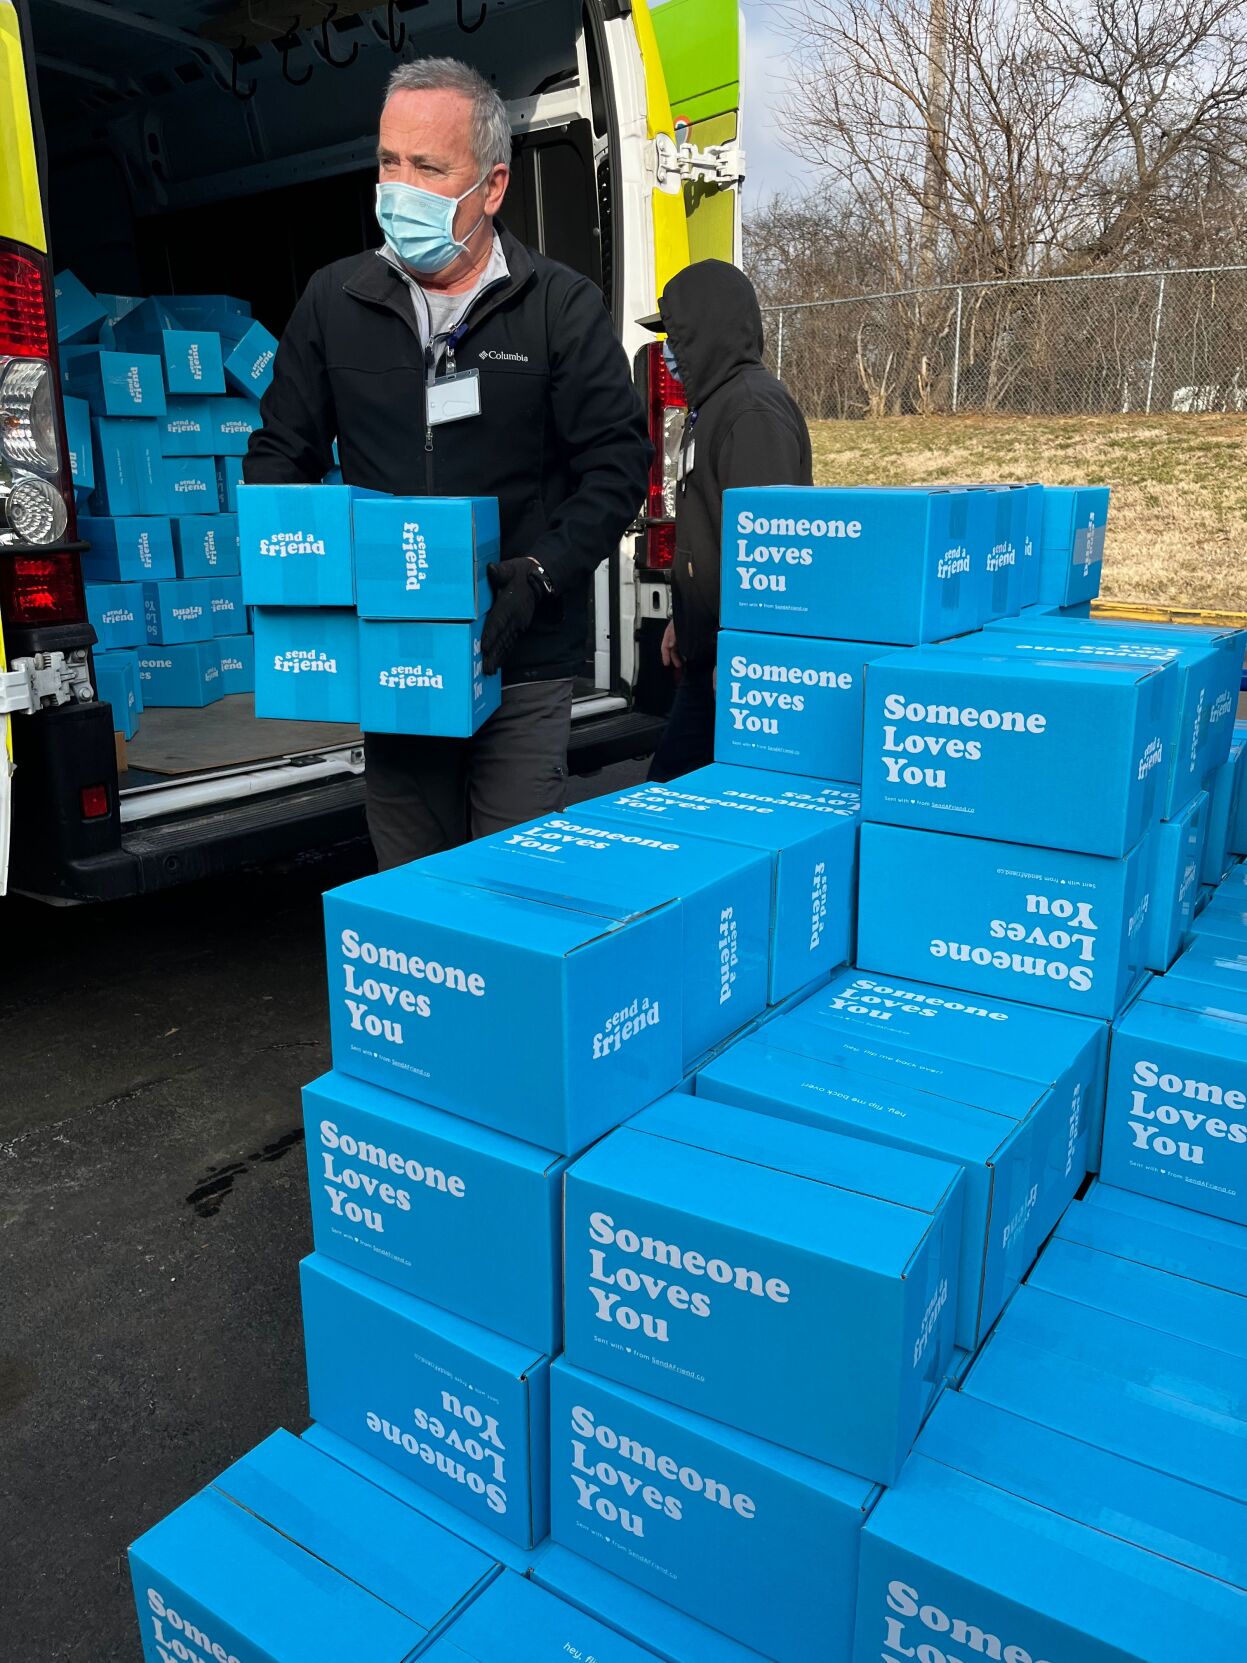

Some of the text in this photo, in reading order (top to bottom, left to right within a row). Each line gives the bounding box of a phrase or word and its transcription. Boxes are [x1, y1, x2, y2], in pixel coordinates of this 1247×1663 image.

[191, 344, 202, 380] friend
[251, 350, 274, 379] friend
[489, 351, 528, 362] Columbia
[131, 367, 142, 403] friend
[168, 424, 200, 432] friend
[221, 424, 253, 432] friend
[175, 484, 206, 492] friend
[271, 531, 314, 542] send a
[737, 511, 861, 537] Someone
[140, 532, 151, 568] friend
[207, 531, 216, 564] friend
[259, 538, 325, 557] friend
[403, 522, 420, 591] friend
[416, 535, 428, 580] send a
[737, 540, 812, 565] Loves
[945, 546, 965, 561] send a
[986, 549, 1015, 572] friend
[992, 541, 1006, 555] send
[1008, 543, 1011, 552] a
[736, 567, 786, 591] You
[938, 555, 970, 578] friend
[103, 613, 133, 623] friend
[172, 607, 202, 616] friend
[274, 656, 337, 673] friend
[285, 649, 327, 660] send a
[391, 665, 433, 676] send a
[380, 671, 443, 688] friend
[731, 656, 852, 689] Someone
[730, 682, 804, 711] Loves
[1210, 697, 1232, 722] friend
[1216, 690, 1227, 705] send
[729, 708, 778, 734] You
[883, 694, 1047, 734] Someone
[882, 726, 981, 760] Loves
[1145, 737, 1156, 758] send
[881, 757, 947, 788] You
[1138, 744, 1162, 781] friend
[613, 797, 667, 812] You
[625, 792, 710, 811] Loves
[645, 787, 774, 814] Someone
[723, 790, 853, 816] Someone
[504, 834, 563, 853] You
[521, 827, 610, 851] Loves
[543, 819, 681, 852] Someone
[810, 862, 825, 951] friend
[819, 875, 827, 916] send
[1026, 894, 1098, 929] You
[719, 906, 733, 1005] friend
[729, 921, 738, 983] send a
[990, 919, 1096, 961] Loves
[341, 929, 485, 997] Someone
[930, 939, 1093, 991] Someone
[343, 964, 431, 1018] Loves
[838, 988, 938, 1017] Loves
[851, 979, 1008, 1021] Someone
[345, 1000, 403, 1046] You
[605, 997, 650, 1033] send a
[829, 998, 892, 1021] You
[592, 1002, 659, 1060] friend
[1133, 1061, 1247, 1109] Some
[1130, 1091, 1247, 1143] Loves
[320, 1120, 466, 1198] Someone
[1128, 1122, 1204, 1165] You
[322, 1152, 411, 1211] Loves
[324, 1185, 384, 1232] You
[589, 1211, 791, 1304] Someone
[589, 1248, 711, 1318] Loves
[588, 1286, 669, 1343] You
[913, 1285, 947, 1368] friend
[594, 1335, 609, 1345] Sent
[610, 1341, 624, 1351] with
[633, 1348, 650, 1361] from
[441, 1391, 505, 1450] You
[366, 1411, 507, 1514] Someone
[414, 1408, 506, 1483] Loves
[571, 1405, 756, 1518] Someone
[571, 1440, 682, 1521] Loves
[571, 1475, 644, 1537] You
[148, 1588, 241, 1663] Some
[887, 1581, 1053, 1663] Some
